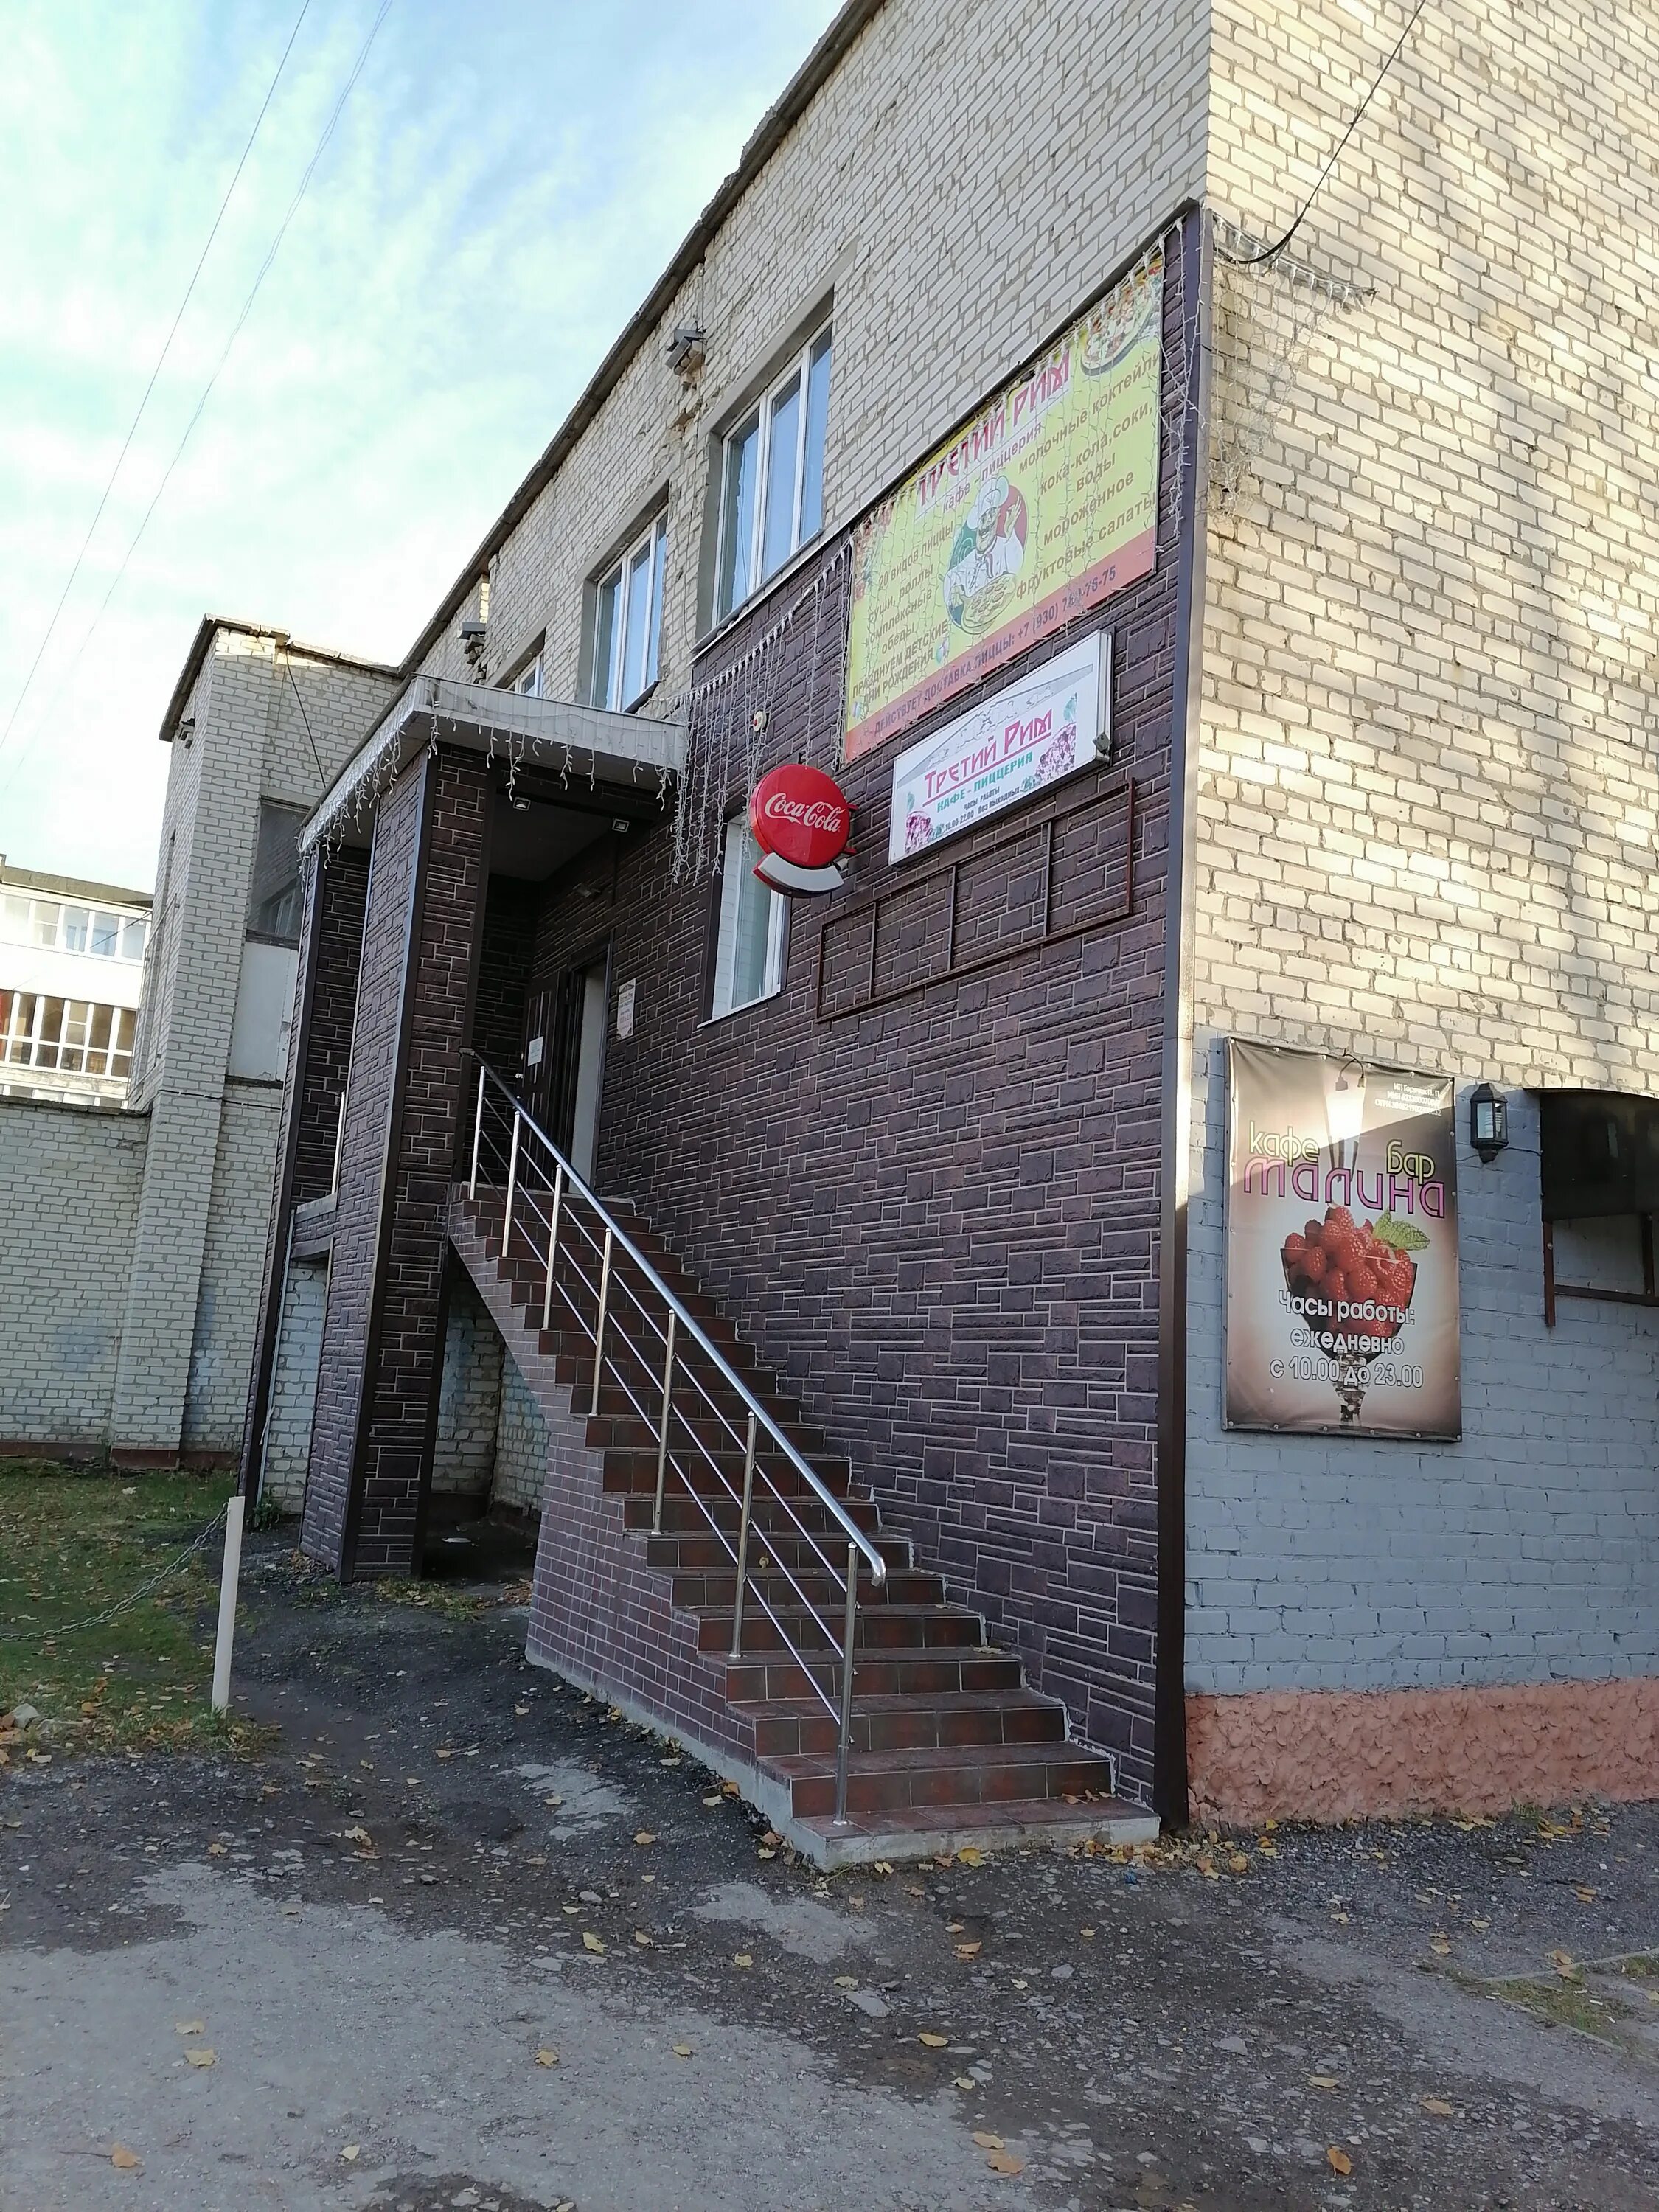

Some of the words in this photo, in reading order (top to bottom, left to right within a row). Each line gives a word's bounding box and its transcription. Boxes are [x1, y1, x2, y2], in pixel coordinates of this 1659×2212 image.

[943, 482, 970, 513] кафе
[981, 422, 1042, 478] пиццерия
[1019, 410, 1088, 474] молочные
[1076, 452, 1116, 493] воды
[1044, 471, 1134, 546] мороженное
[878, 571, 889, 591] 20
[891, 551, 919, 581] видов
[922, 521, 953, 557] пиццы
[1016, 535, 1093, 600] фруктовые
[1099, 492, 1155, 540] салаты
[899, 564, 933, 602] роллы
[853, 652, 903, 698] ПРАЗДНУЕМ
[904, 619, 948, 661] ДЕТСКИЕ
[882, 622, 914, 654] обеды
[874, 697, 921, 737] ДЕЙСТВУЕТ
[924, 660, 972, 704] ДОСТАВКА
[1032, 603, 1059, 634] (930)
[883, 647, 933, 694] РОЖДЕНИЯ
[973, 751, 1033, 793] ПИЦЦЕРИЯ
[1249, 1120, 1320, 1167] кафе
[1386, 1139, 1435, 1186] бар
[1279, 1290, 1332, 1317] Часы
[1337, 1299, 1415, 1325] работы:
[1290, 1328, 1405, 1355] ежедневно
[1289, 1356, 1340, 1382] 10.00
[1343, 1362, 1371, 1386] до
[1374, 1363, 1423, 1388] 23.00
